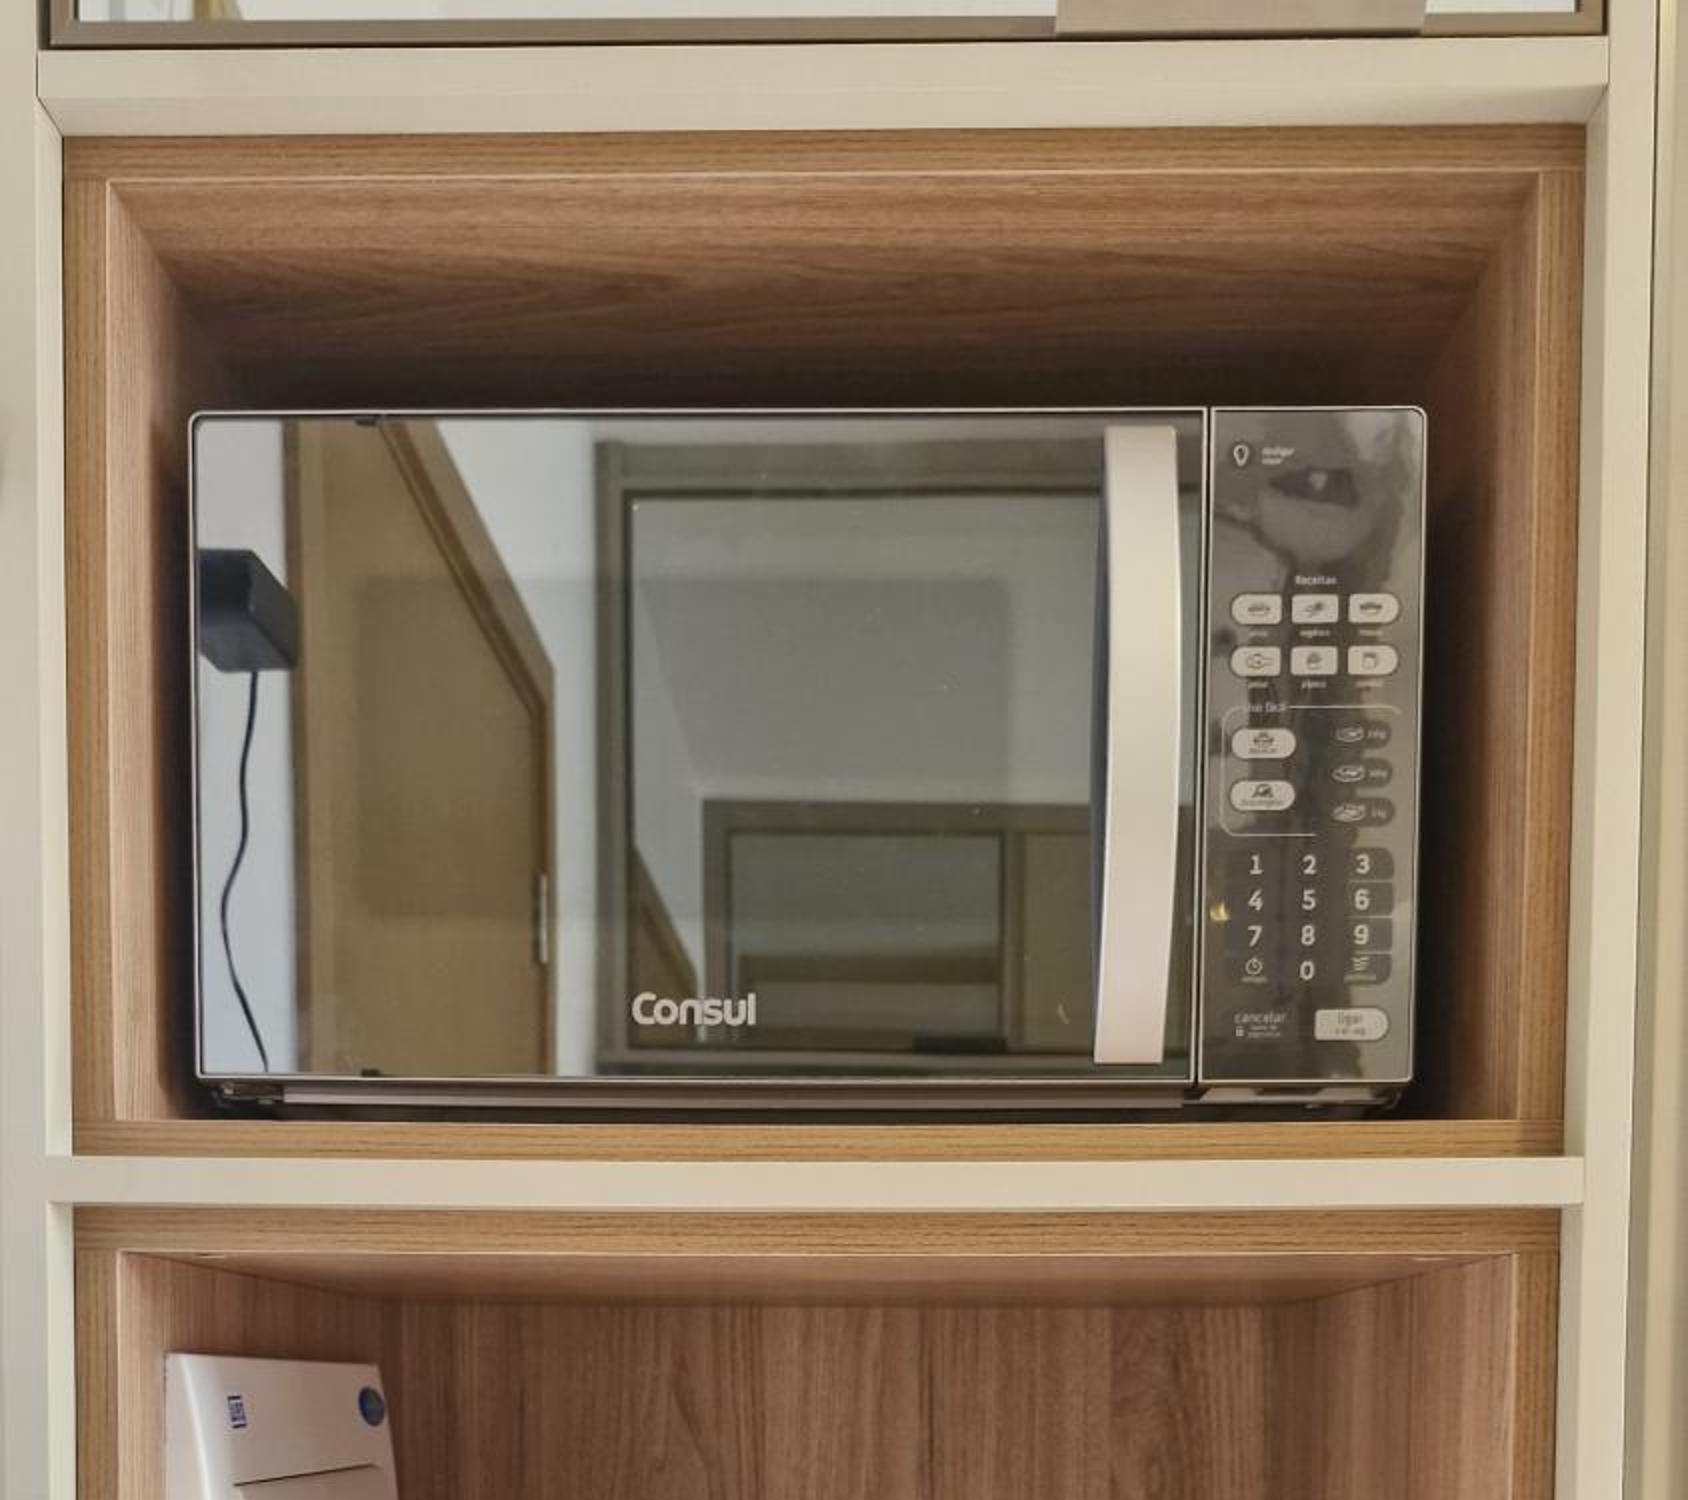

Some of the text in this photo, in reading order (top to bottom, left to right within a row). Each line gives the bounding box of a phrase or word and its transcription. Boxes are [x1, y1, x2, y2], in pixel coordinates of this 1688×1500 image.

[1249, 853, 1371, 875] 1 2 3
[1248, 889, 1370, 911] 4 5 6
[1247, 924, 1369, 947] 7 8 9
[1300, 961, 1315, 981] 0
[631, 991, 757, 1026] Consul
